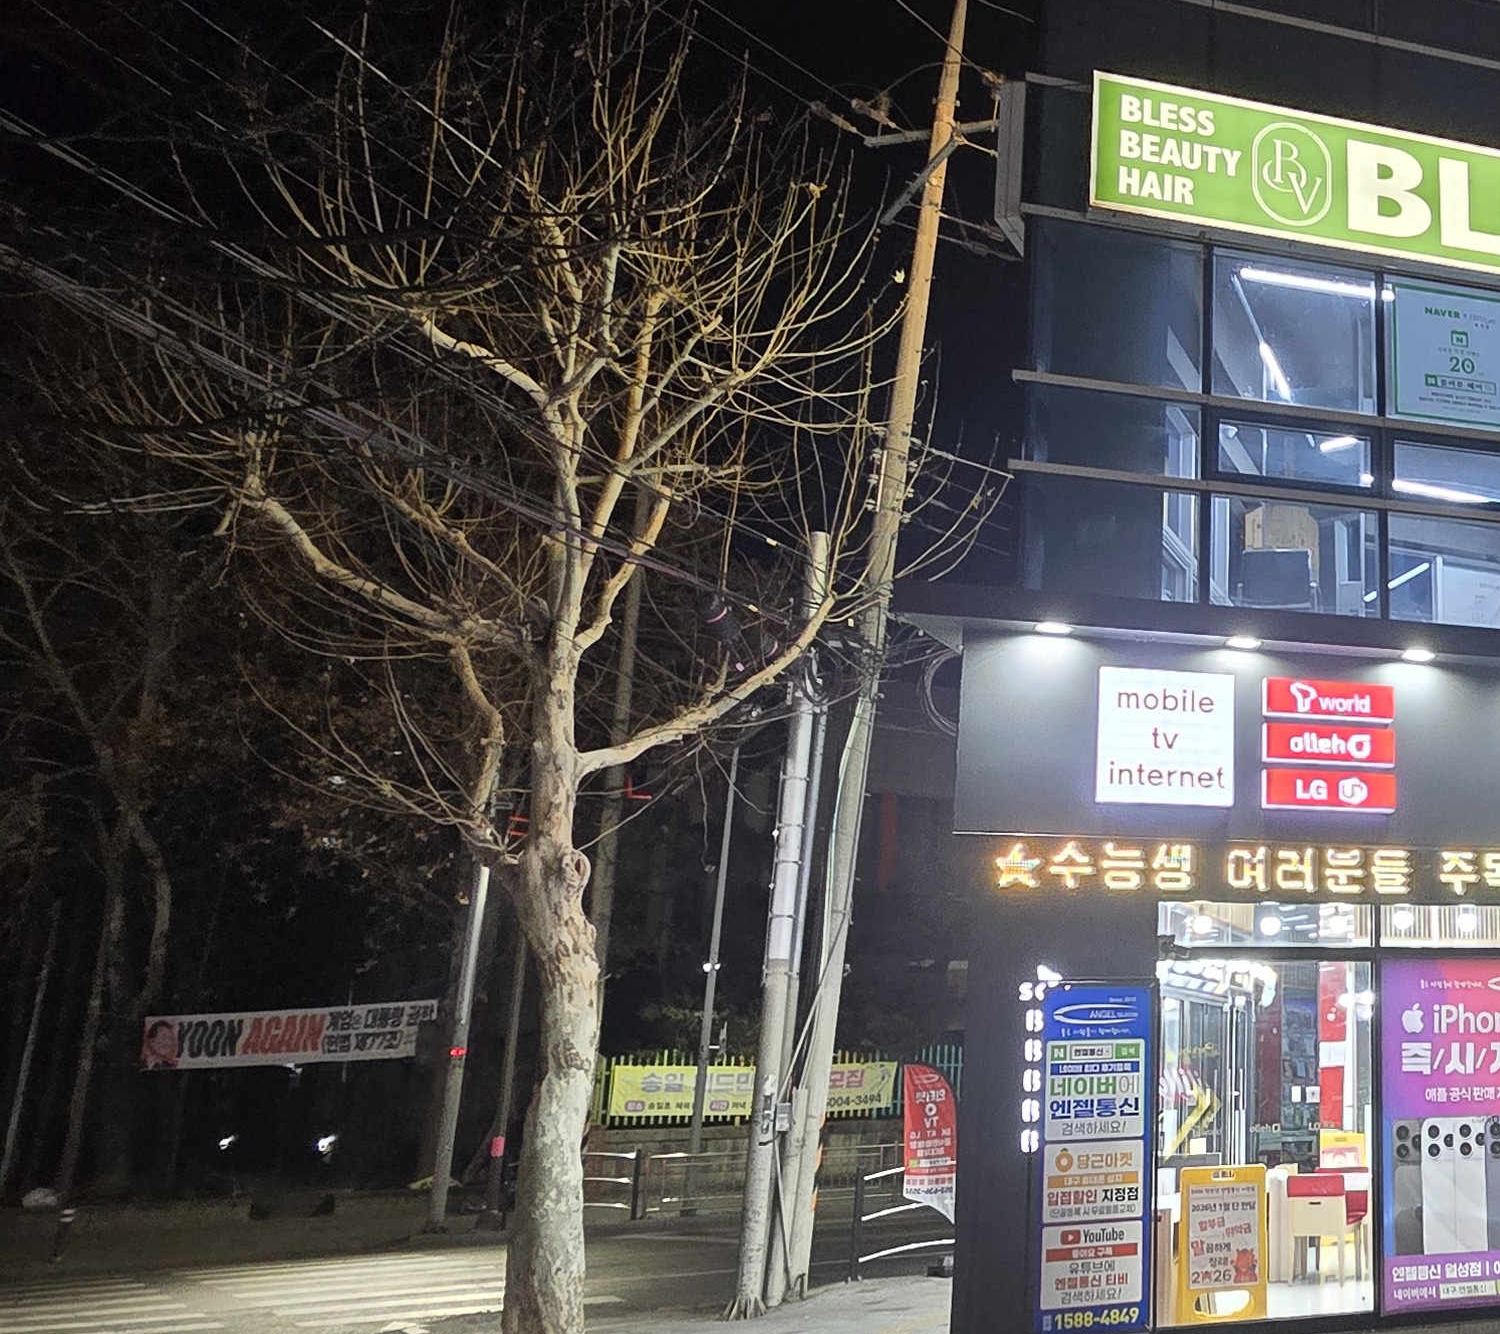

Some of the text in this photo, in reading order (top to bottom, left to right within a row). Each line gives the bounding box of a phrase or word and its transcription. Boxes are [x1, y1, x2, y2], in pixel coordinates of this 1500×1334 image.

[1120, 94, 1215, 137] BLESS
[1119, 130, 1242, 178] BEAUTY
[1118, 165, 1194, 206] HAIR
[1425, 307, 1460, 319] NAVER
[1449, 356, 1476, 374] 20
[1117, 688, 1216, 714] mobile
[1318, 694, 1371, 715] world
[1151, 727, 1179, 750] tv
[1290, 734, 1347, 756] olleh
[1108, 761, 1226, 790] internet
[1295, 778, 1328, 801] LG
[1049, 840, 1195, 891] 수능생
[1227, 847, 1415, 896] 여러분들
[177, 1017, 326, 1059] YOON AGAIN
[1054, 1048, 1064, 1058] N
[1050, 1075, 1140, 1097] 네이버에
[1425, 1087, 1448, 1102] 애플
[1449, 1087, 1471, 1102] 공식
[1473, 1086, 1496, 1101] 판매
[1050, 1097, 1139, 1120] 엔젤통신
[1062, 1120, 1126, 1136] 검색하세요!
[1077, 1152, 1133, 1169] 당근마켓
[1101, 1187, 1139, 1203] 지정점
[1083, 1227, 1125, 1243] YouTube
[1069, 1260, 1116, 1275] 유튜브에
[1055, 1273, 1128, 1290] 엔젤통신 티비
[1061, 1288, 1122, 1304] 검색하세요!
[1393, 1286, 1437, 1300] 네이버에서
[1054, 1307, 1139, 1330] 1588-4849
